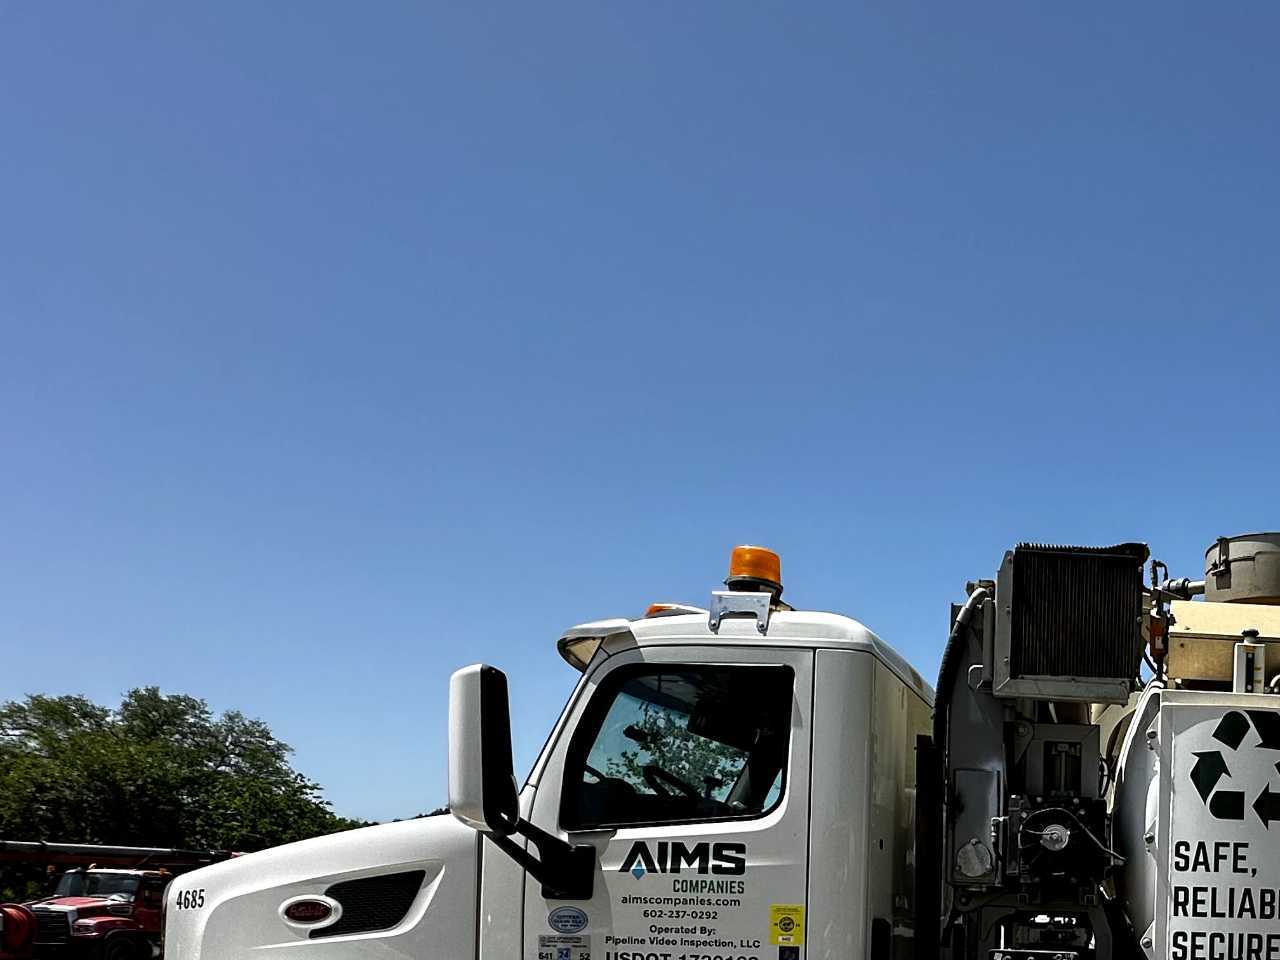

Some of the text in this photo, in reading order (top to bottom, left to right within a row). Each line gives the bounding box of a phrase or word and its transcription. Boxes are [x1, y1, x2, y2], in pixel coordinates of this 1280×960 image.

[618, 841, 747, 876] AIMS
[1174, 841, 1257, 878] SAFE,
[673, 879, 745, 894] COMPANIES
[176, 888, 205, 910] 4685
[621, 894, 741, 907] aimscompanies.com
[643, 909, 718, 920] 602-237-0292
[649, 924, 717, 937] Operated By:
[605, 935, 761, 949] Pipeline Video Inspection, LLC
